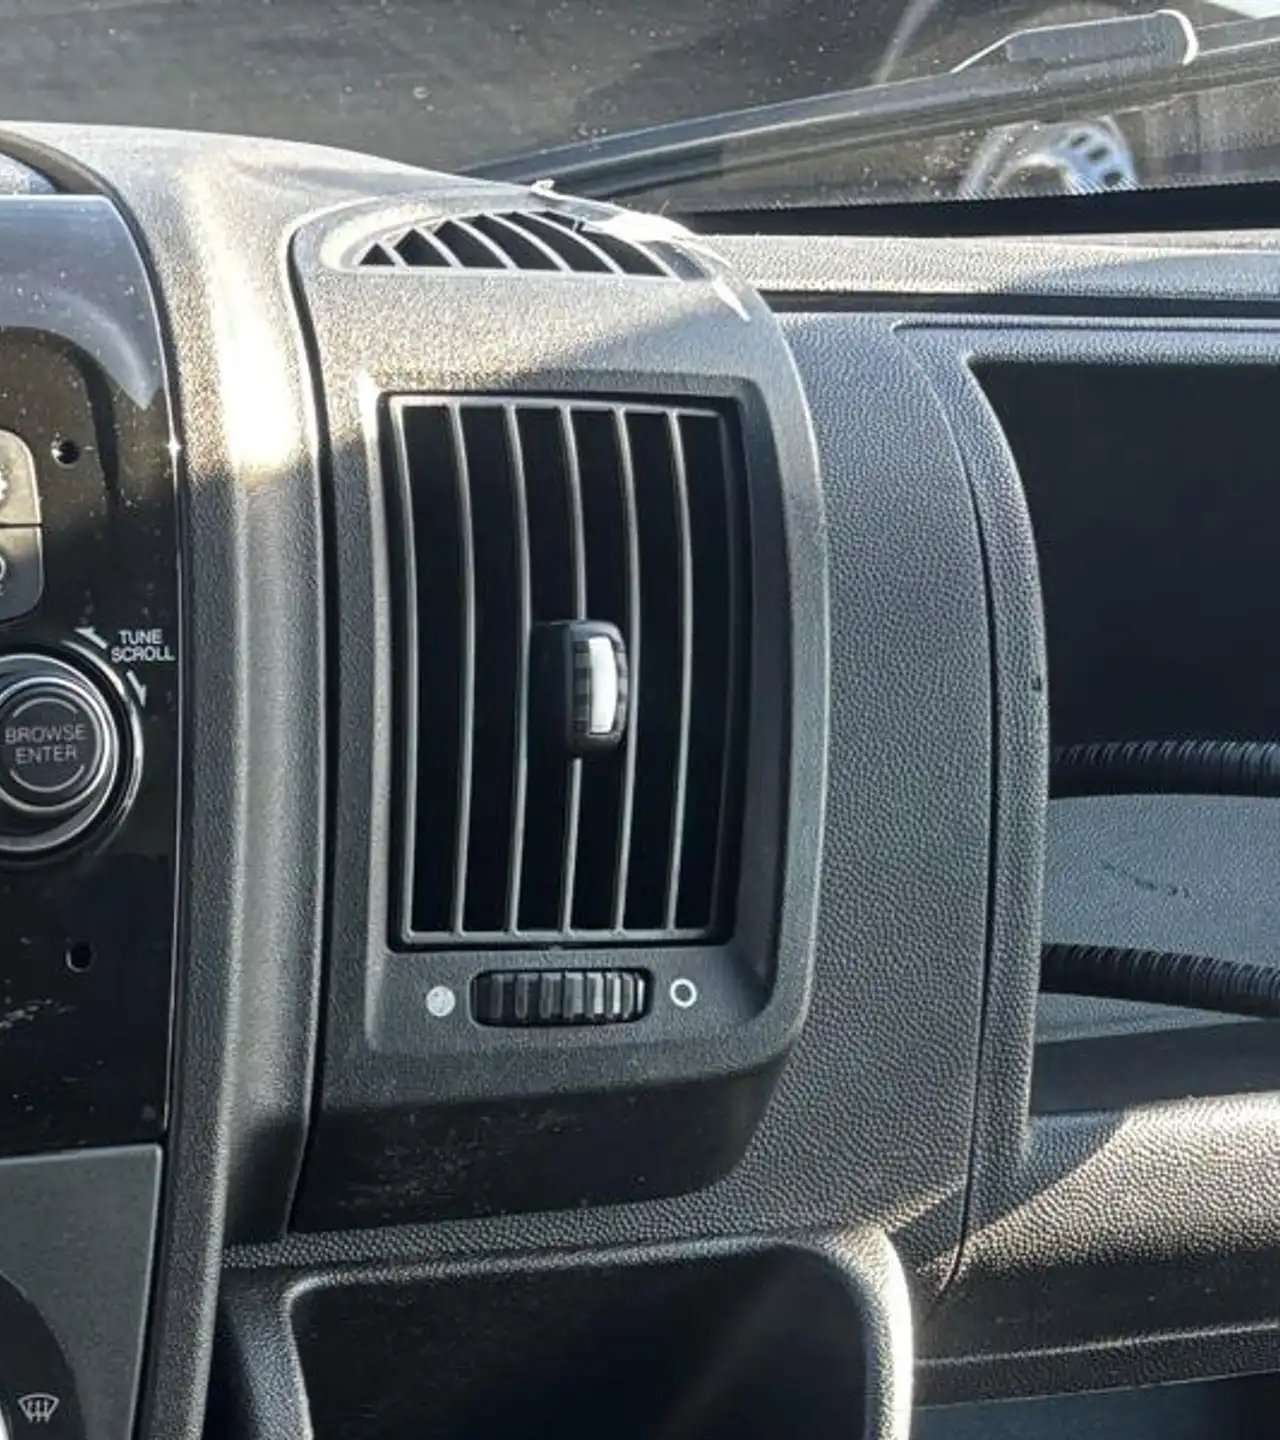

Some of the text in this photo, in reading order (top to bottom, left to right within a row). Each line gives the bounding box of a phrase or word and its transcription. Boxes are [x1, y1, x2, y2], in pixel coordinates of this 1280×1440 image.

[118, 629, 163, 646] TUNE
[110, 645, 175, 663] SCROLL
[3, 722, 88, 745] BROWSE
[14, 743, 78, 765] ENTER
